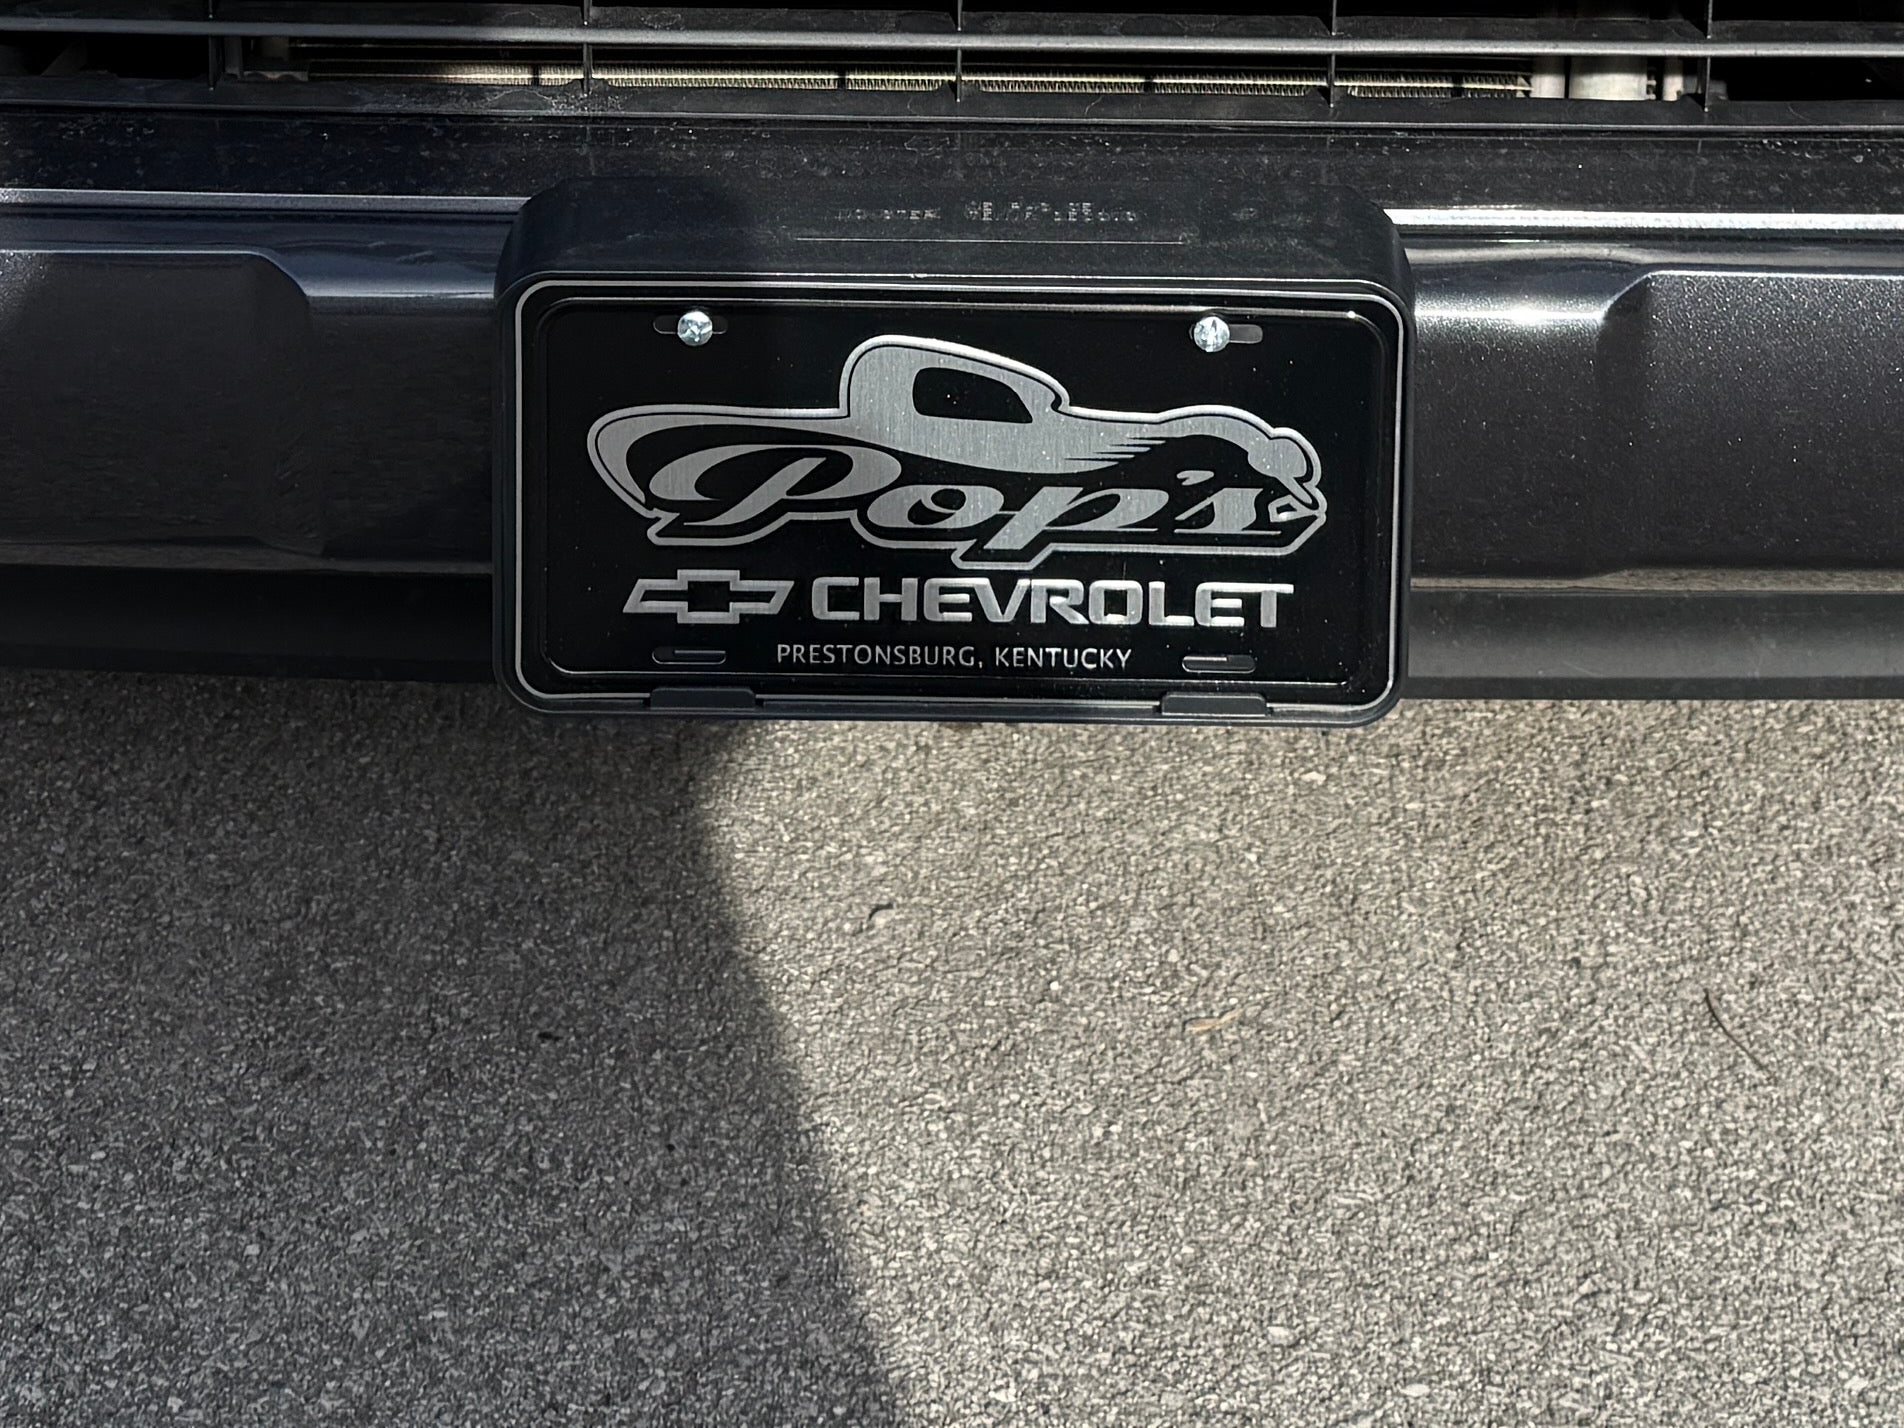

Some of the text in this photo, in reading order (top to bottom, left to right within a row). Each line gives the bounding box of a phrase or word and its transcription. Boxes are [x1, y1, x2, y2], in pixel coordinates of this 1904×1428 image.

[648, 444, 1283, 551] Pop's
[811, 576, 1295, 629] CHEVROLET
[776, 644, 1133, 669] PRESTONSBURG, KENTUCKY
